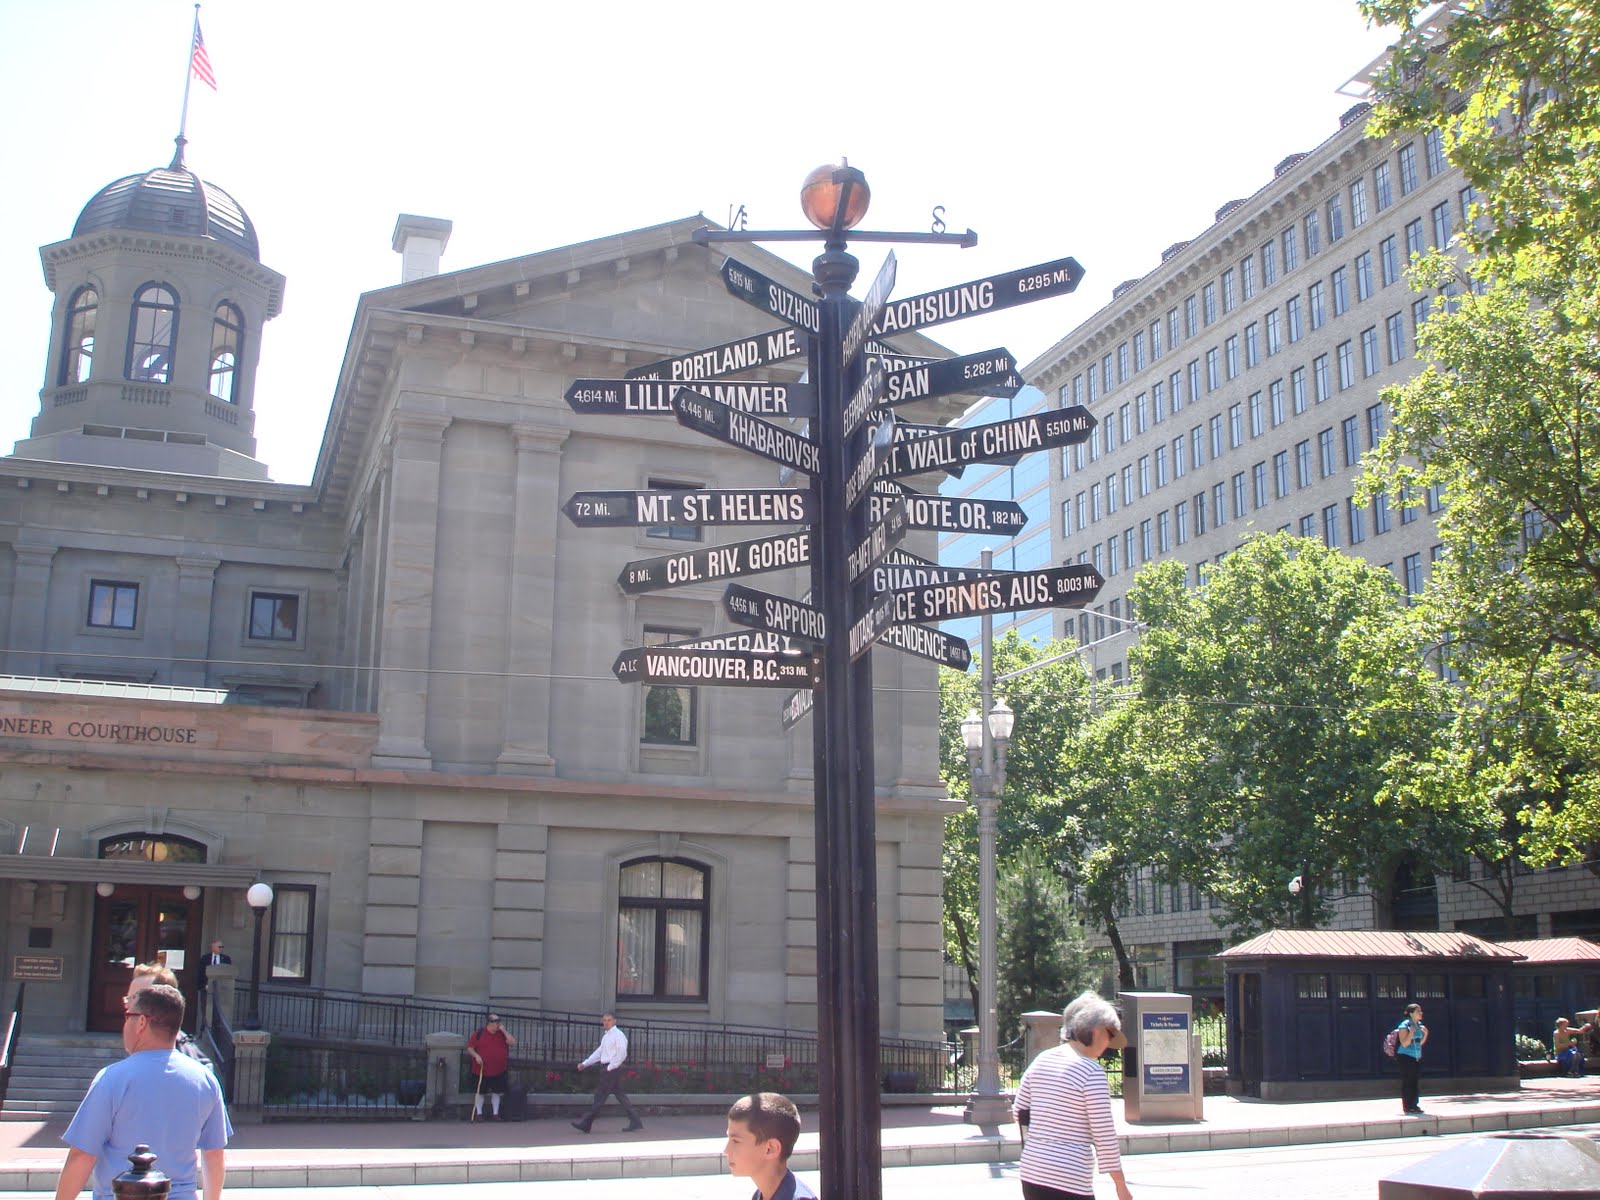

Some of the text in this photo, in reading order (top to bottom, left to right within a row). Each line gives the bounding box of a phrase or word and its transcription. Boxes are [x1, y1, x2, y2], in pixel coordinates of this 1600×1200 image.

[1018, 273, 1051, 293] 6,295
[1053, 269, 1071, 285] Mi.
[769, 284, 820, 333] SUZHOU
[672, 341, 763, 381] PORTLAND,
[767, 329, 801, 361] ME.
[573, 389, 603, 403] 4,614
[605, 390, 619, 404] Mi.
[878, 368, 929, 404] SAN
[964, 360, 992, 379] 5,282
[843, 374, 873, 438] ELEPHANTS
[680, 398, 821, 474] 4,446 Mi. KHABAROVSK
[907, 436, 957, 469] WALL
[961, 431, 977, 460] of
[1046, 421, 1071, 437] 5,510
[1073, 416, 1089, 431] Mi.
[576, 494, 804, 523] 72 Mi. MT. ST. HELENS
[992, 511, 1008, 525] 182
[1010, 513, 1024, 526] Mi.
[629, 535, 809, 584] 8 Mi. COL. RIV. GORGE
[923, 580, 1006, 617] SPRNGS,
[1009, 574, 1054, 607] AUS.
[1057, 576, 1082, 594] 8,003
[1083, 575, 1099, 590] Mi.
[748, 601, 760, 617] Mi.
[765, 598, 825, 640] SAPPORO
[618, 661, 628, 674] A
[646, 655, 750, 682] VANCOUVER,
[753, 659, 780, 681] B.C.
[780, 665, 795, 677] 313
[0, 717, 197, 744] NEER COURTHOUSE
